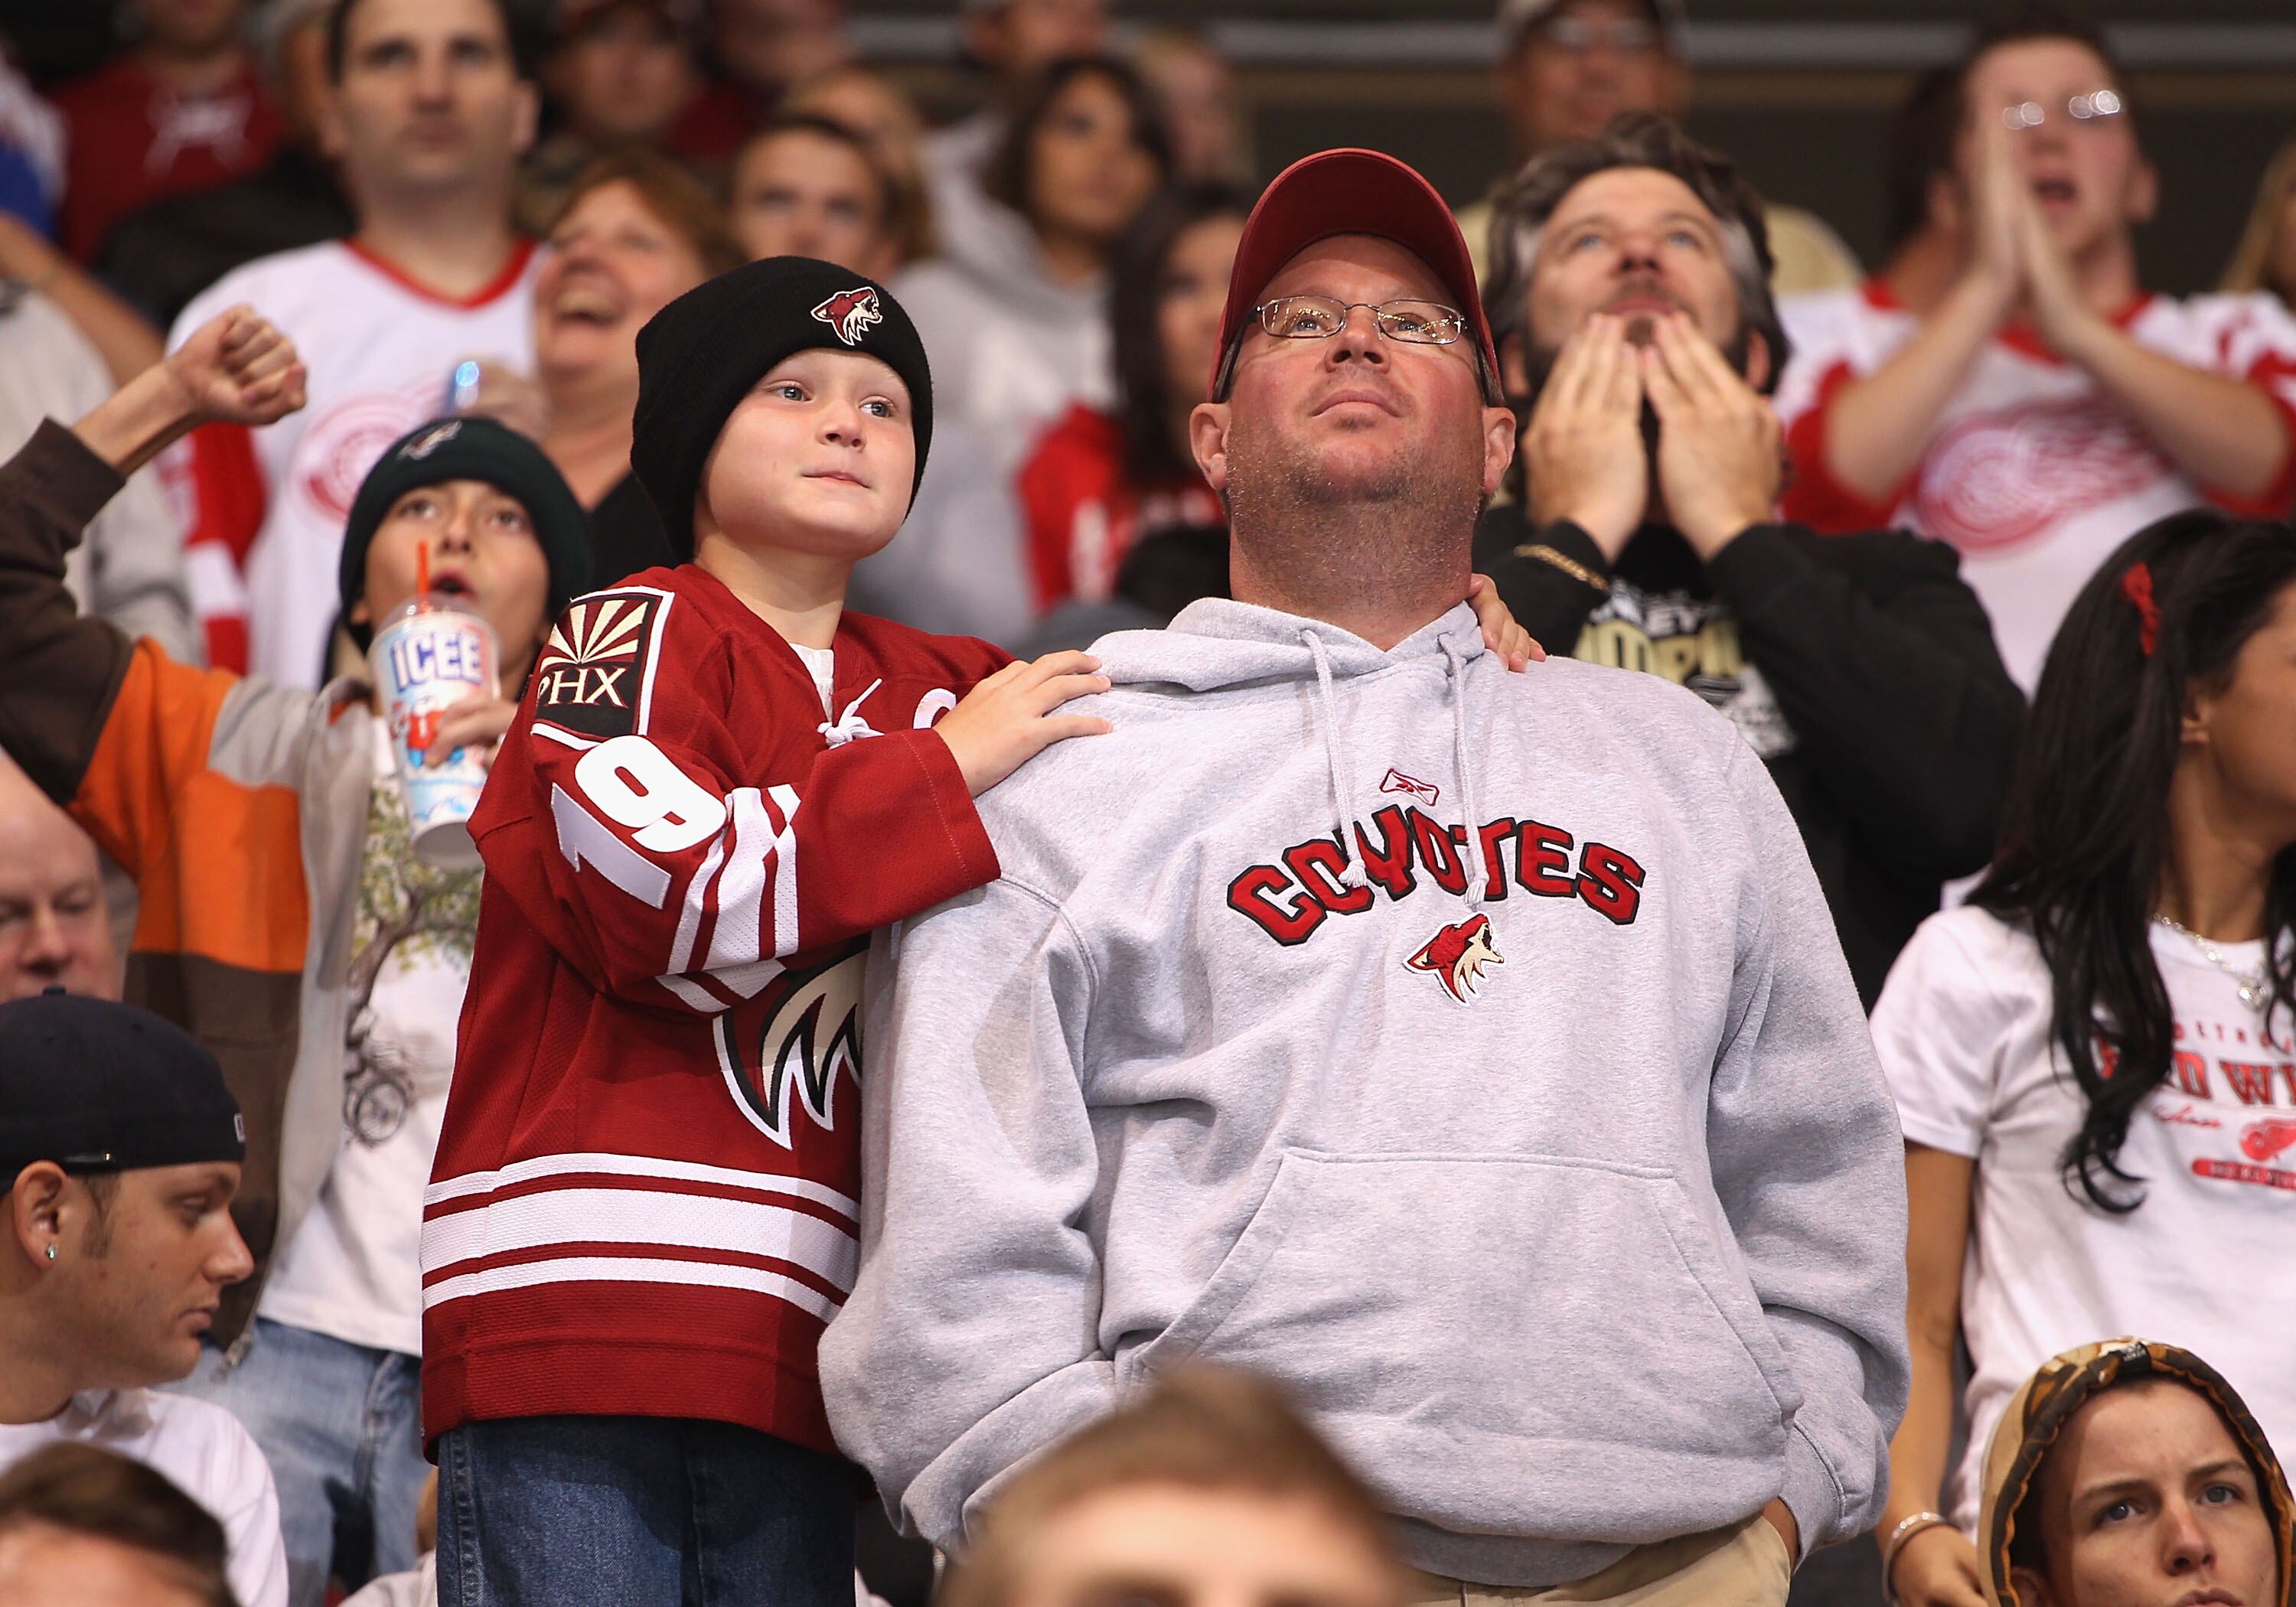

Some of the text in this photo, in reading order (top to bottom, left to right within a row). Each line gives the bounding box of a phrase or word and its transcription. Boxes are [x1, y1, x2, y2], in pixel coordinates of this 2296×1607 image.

[391, 632, 484, 692] ICEE
[550, 735, 727, 911] 19
[1227, 804, 1646, 947] COYOTES
